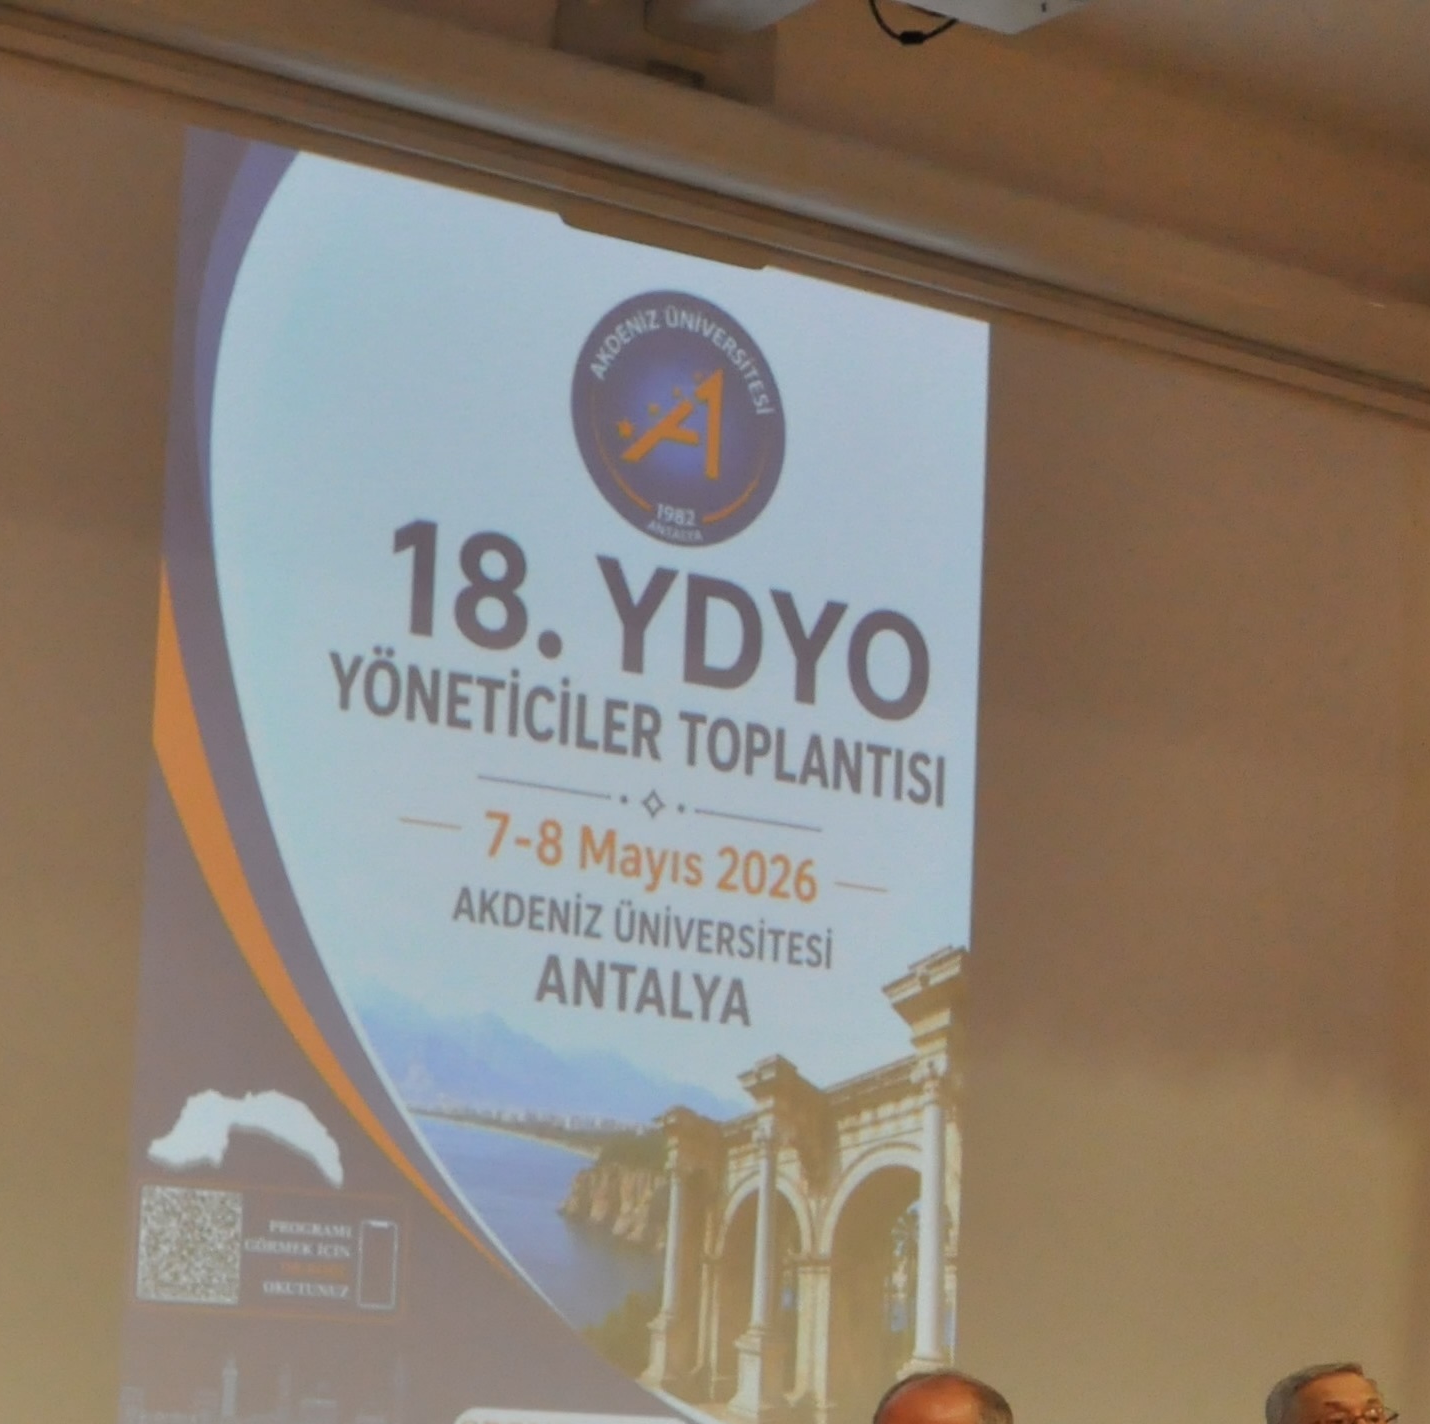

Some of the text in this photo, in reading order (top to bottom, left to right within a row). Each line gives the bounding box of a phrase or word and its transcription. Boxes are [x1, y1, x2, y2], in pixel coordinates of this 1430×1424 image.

[590, 304, 774, 416] AKDENİZ ÜNİVERSİTESİ
[647, 521, 703, 542] ANTALYA
[657, 503, 696, 526] 1982
[392, 519, 930, 721] 18. YDYO
[329, 645, 946, 808] YÖNETİCİLER TOPLANTISI
[485, 811, 818, 903] 7-8 Mayıs 2026
[452, 886, 833, 969] AKDENİZ ÜNİVERSİTESİ
[535, 954, 752, 1026] ANTALYA
